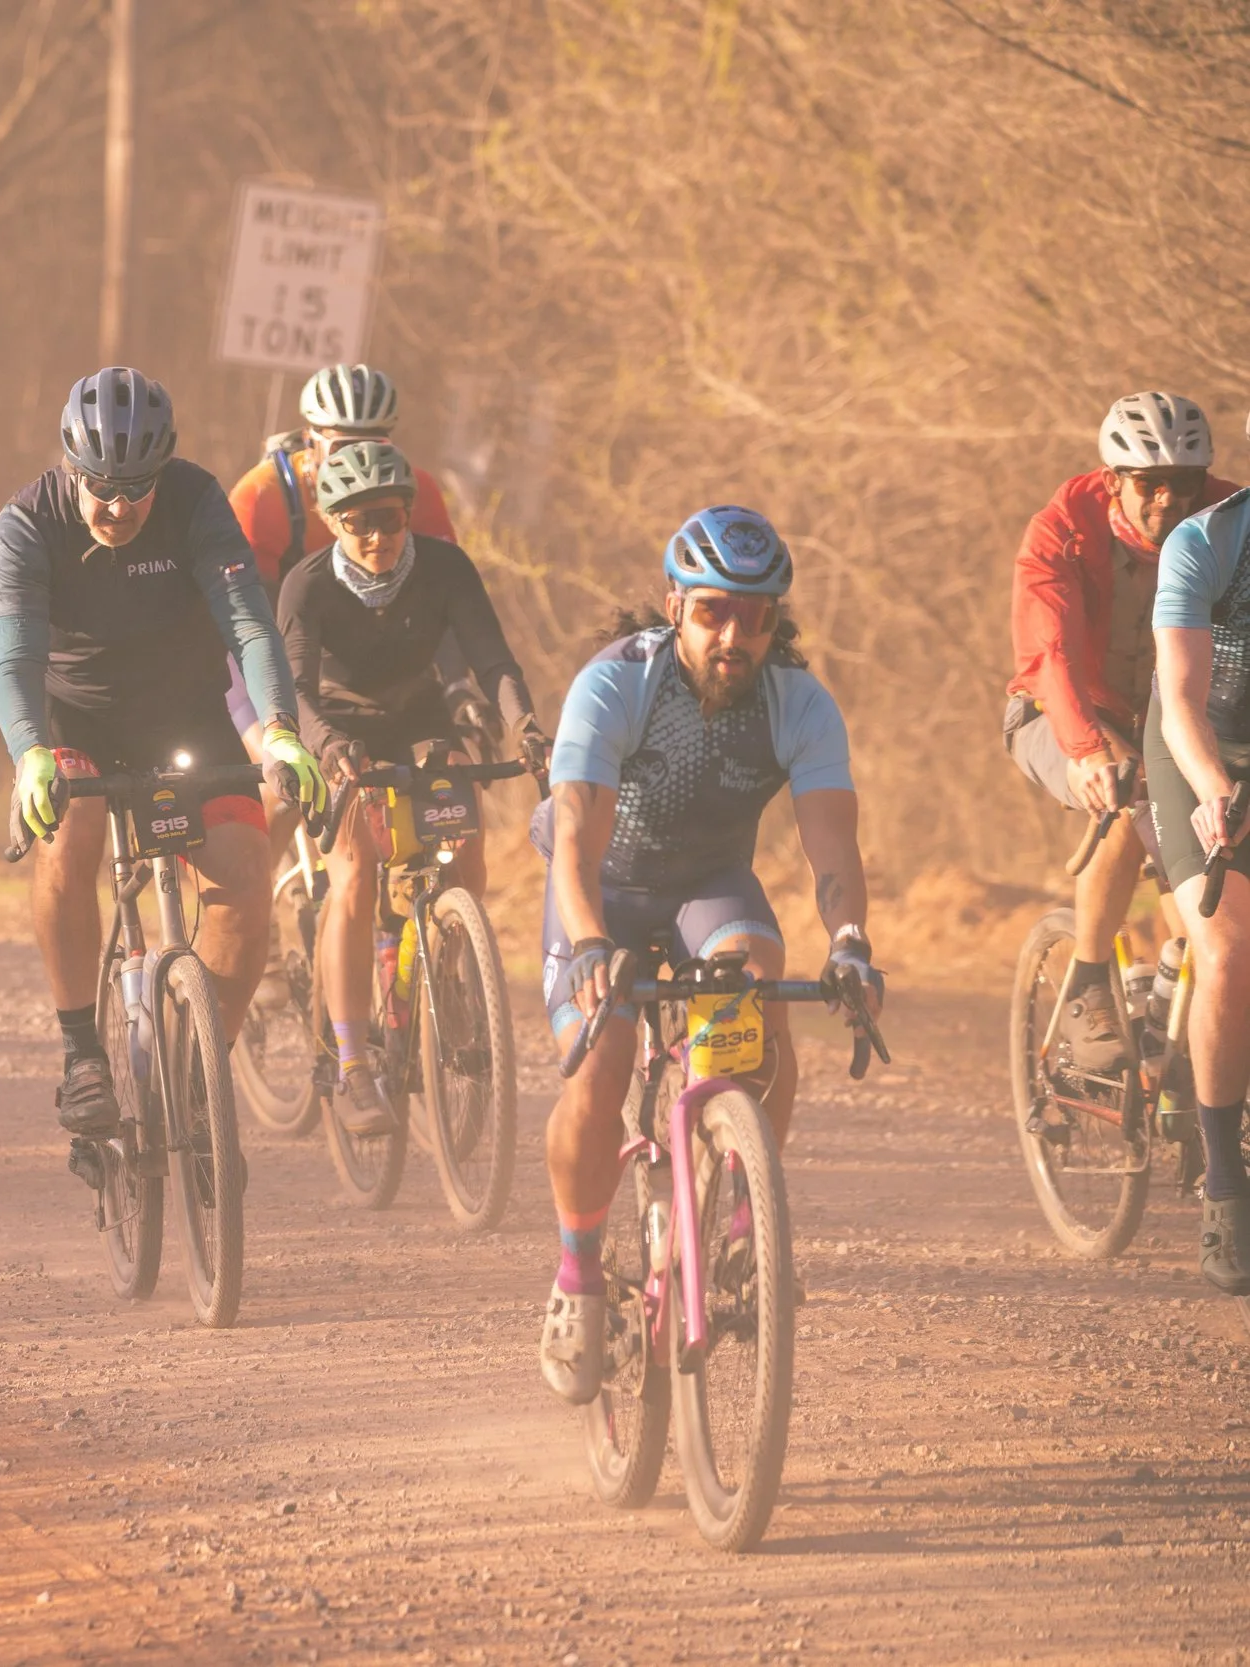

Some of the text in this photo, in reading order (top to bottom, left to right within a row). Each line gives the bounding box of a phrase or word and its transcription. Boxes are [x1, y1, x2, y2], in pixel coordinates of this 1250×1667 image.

[261, 236, 345, 270] LIMIT
[273, 284, 327, 321] 15
[240, 314, 345, 363] TONS
[127, 559, 178, 577] PRIMA
[151, 816, 189, 834] 815
[424, 805, 467, 822] 249
